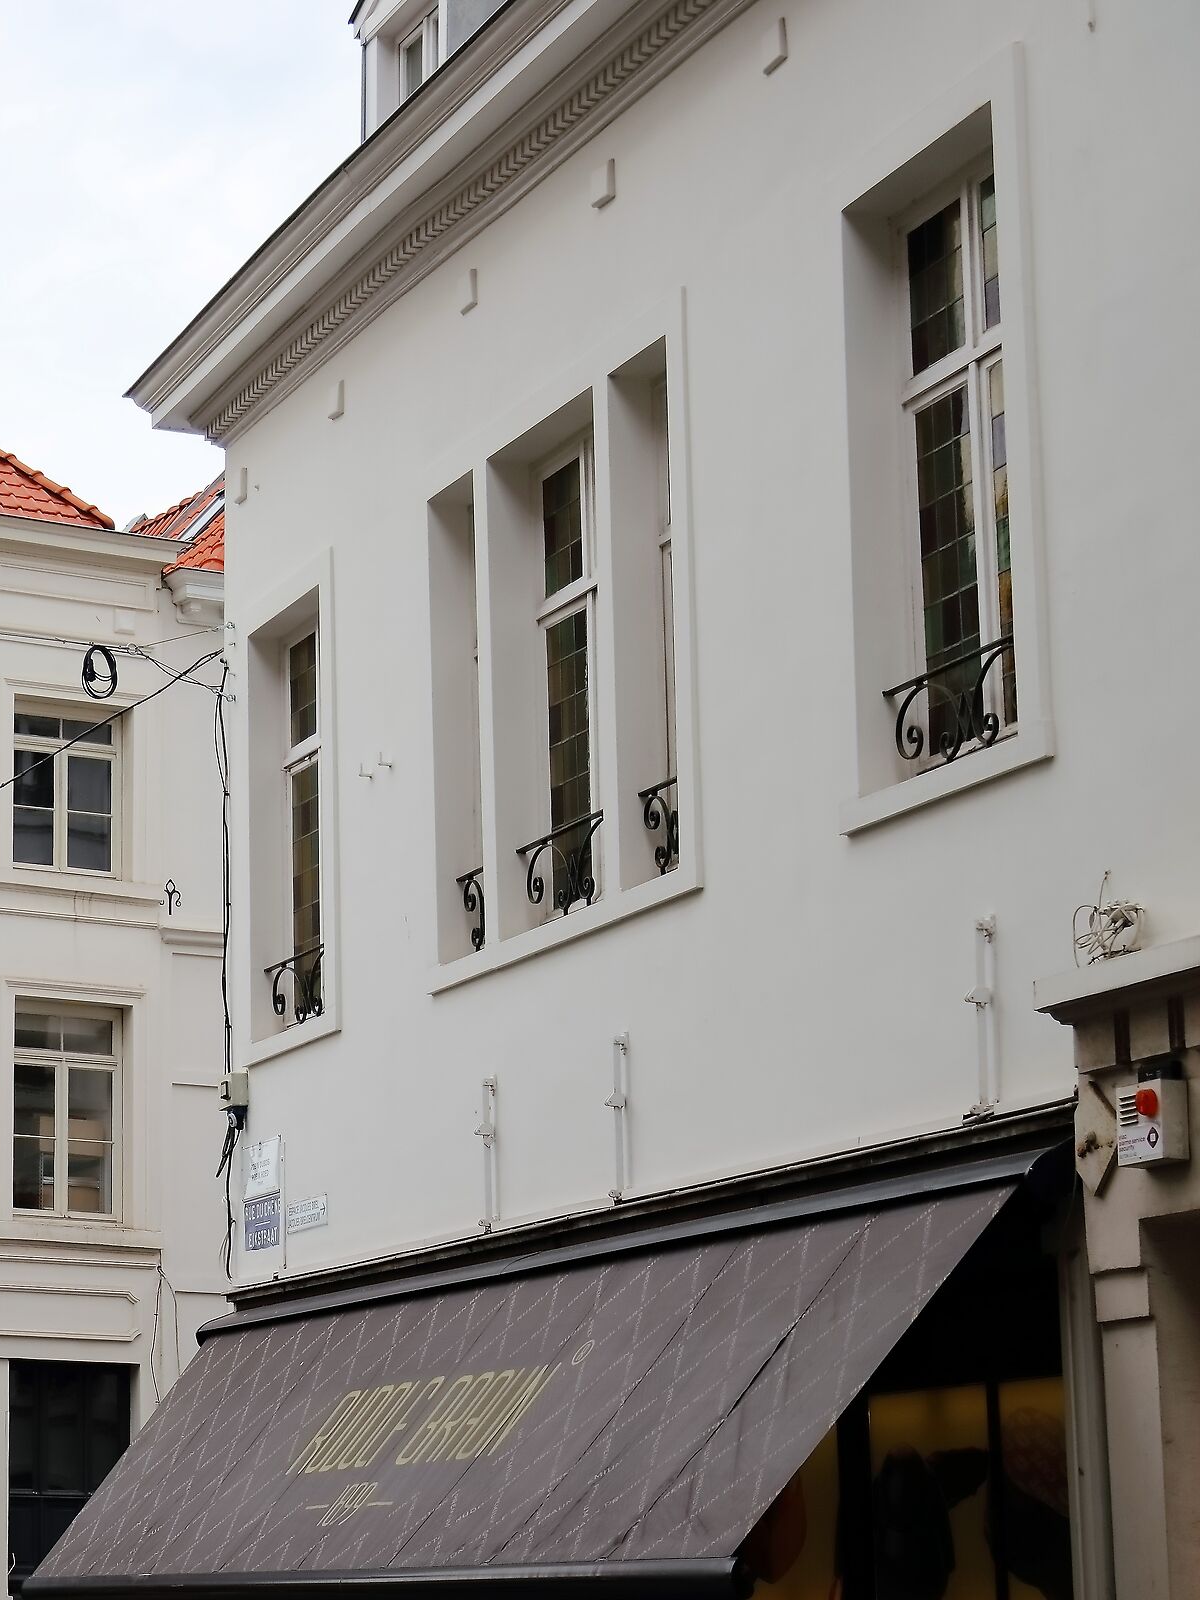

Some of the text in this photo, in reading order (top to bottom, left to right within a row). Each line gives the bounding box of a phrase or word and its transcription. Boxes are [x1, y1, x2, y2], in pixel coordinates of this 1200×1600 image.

[285, 1362, 562, 1475] RUDOLF BRAUN
[316, 1482, 378, 1527] 1899
